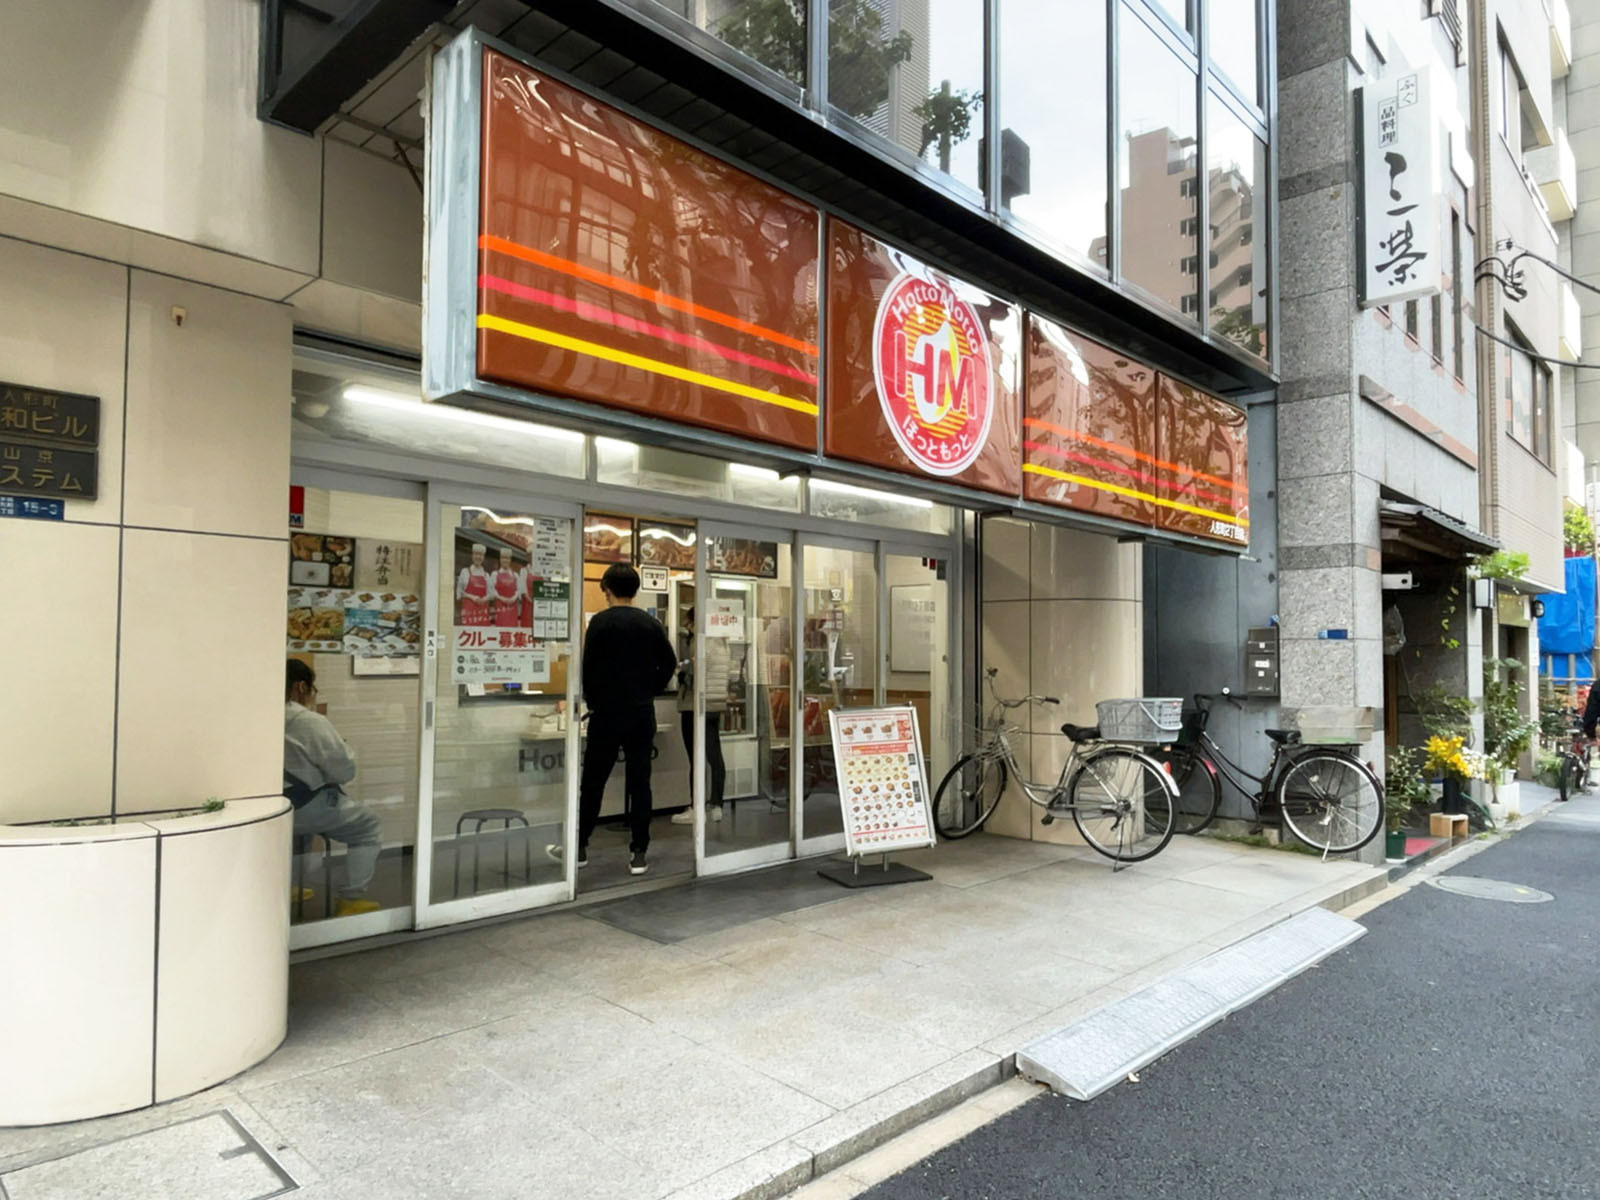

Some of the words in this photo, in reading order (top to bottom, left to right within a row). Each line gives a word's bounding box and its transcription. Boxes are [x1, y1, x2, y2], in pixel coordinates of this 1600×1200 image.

[891, 284, 938, 323] Hotto
[939, 288, 979, 354] Motto
[894, 329, 978, 420] HM
[902, 415, 972, 460] ほっともっと
[0, 465, 82, 491] ステム
